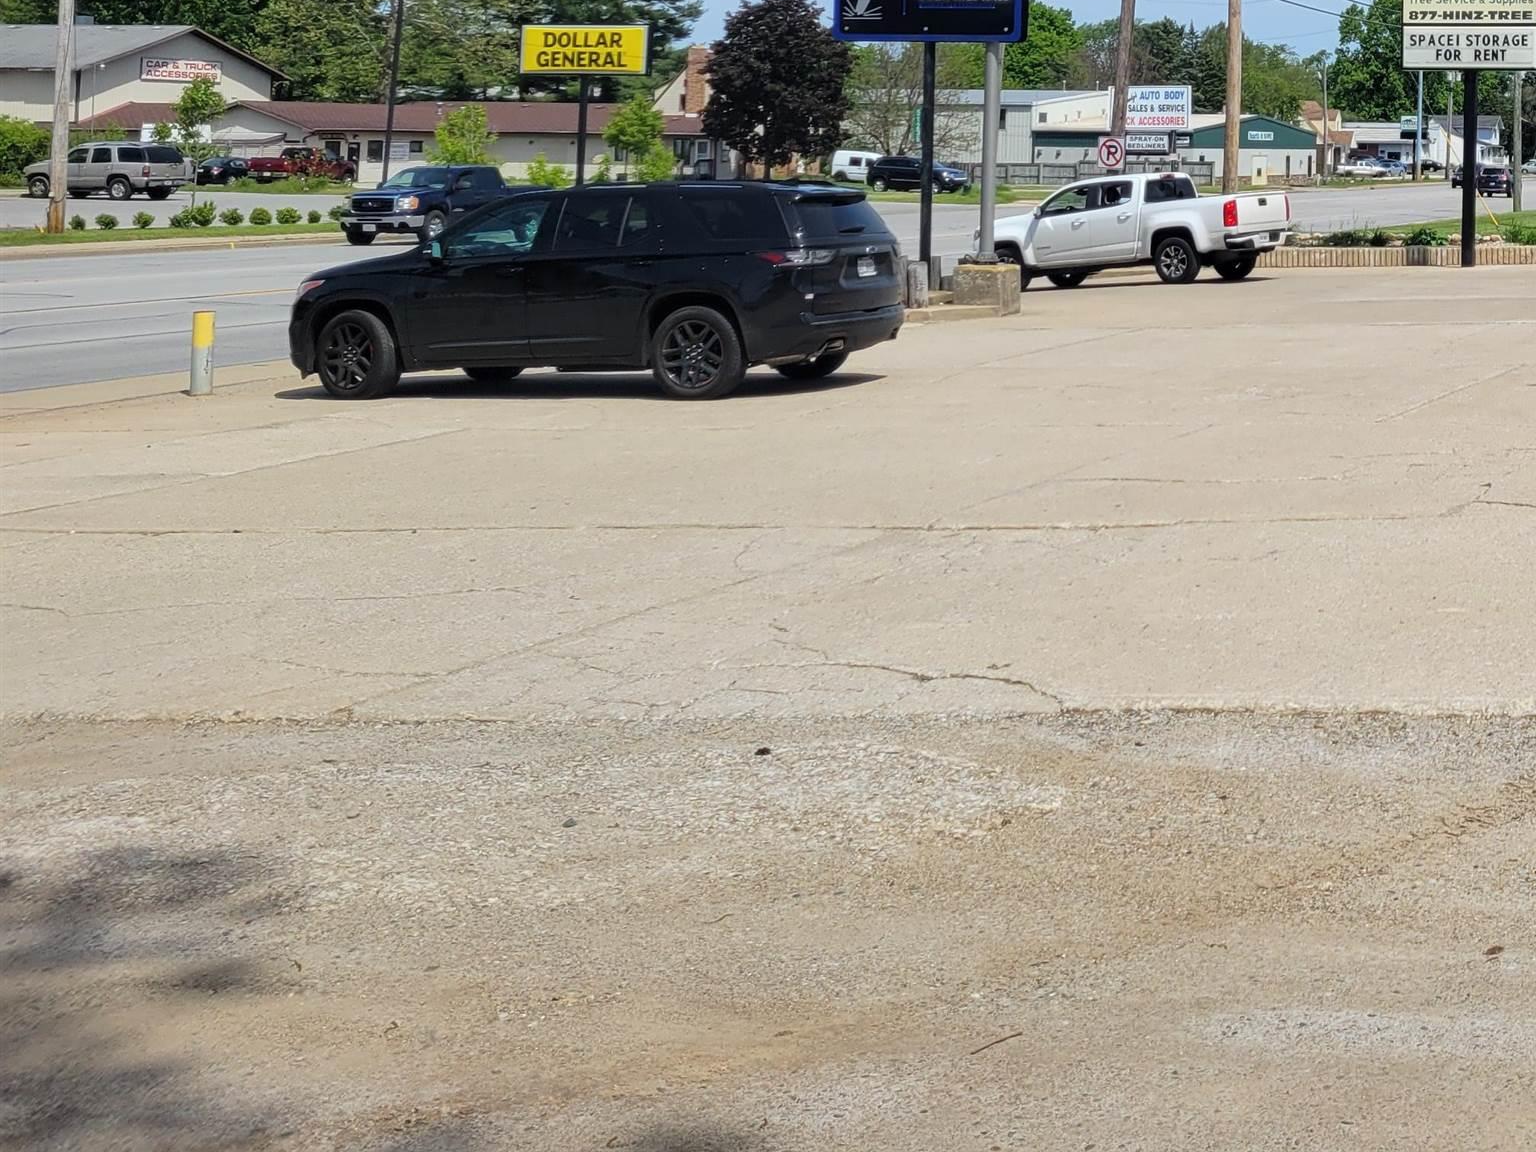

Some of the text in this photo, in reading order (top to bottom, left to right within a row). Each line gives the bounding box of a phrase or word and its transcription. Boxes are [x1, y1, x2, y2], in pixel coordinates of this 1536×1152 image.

[1408, 10, 1533, 20] 877-HINZ-TREE
[543, 31, 623, 48] DOLLAR
[1465, 34, 1529, 47] STORAGE
[536, 51, 628, 68] GENERAL
[1435, 49, 1507, 62] FOR RENT
[146, 60, 218, 71] CAR & TRUCK
[146, 69, 218, 80] ACCESSORIES
[1139, 90, 1185, 100] AUTO BODY
[1127, 104, 1148, 113] SALES
[1158, 104, 1186, 113] SERVICE
[1138, 116, 1186, 126] ACCESSORIES
